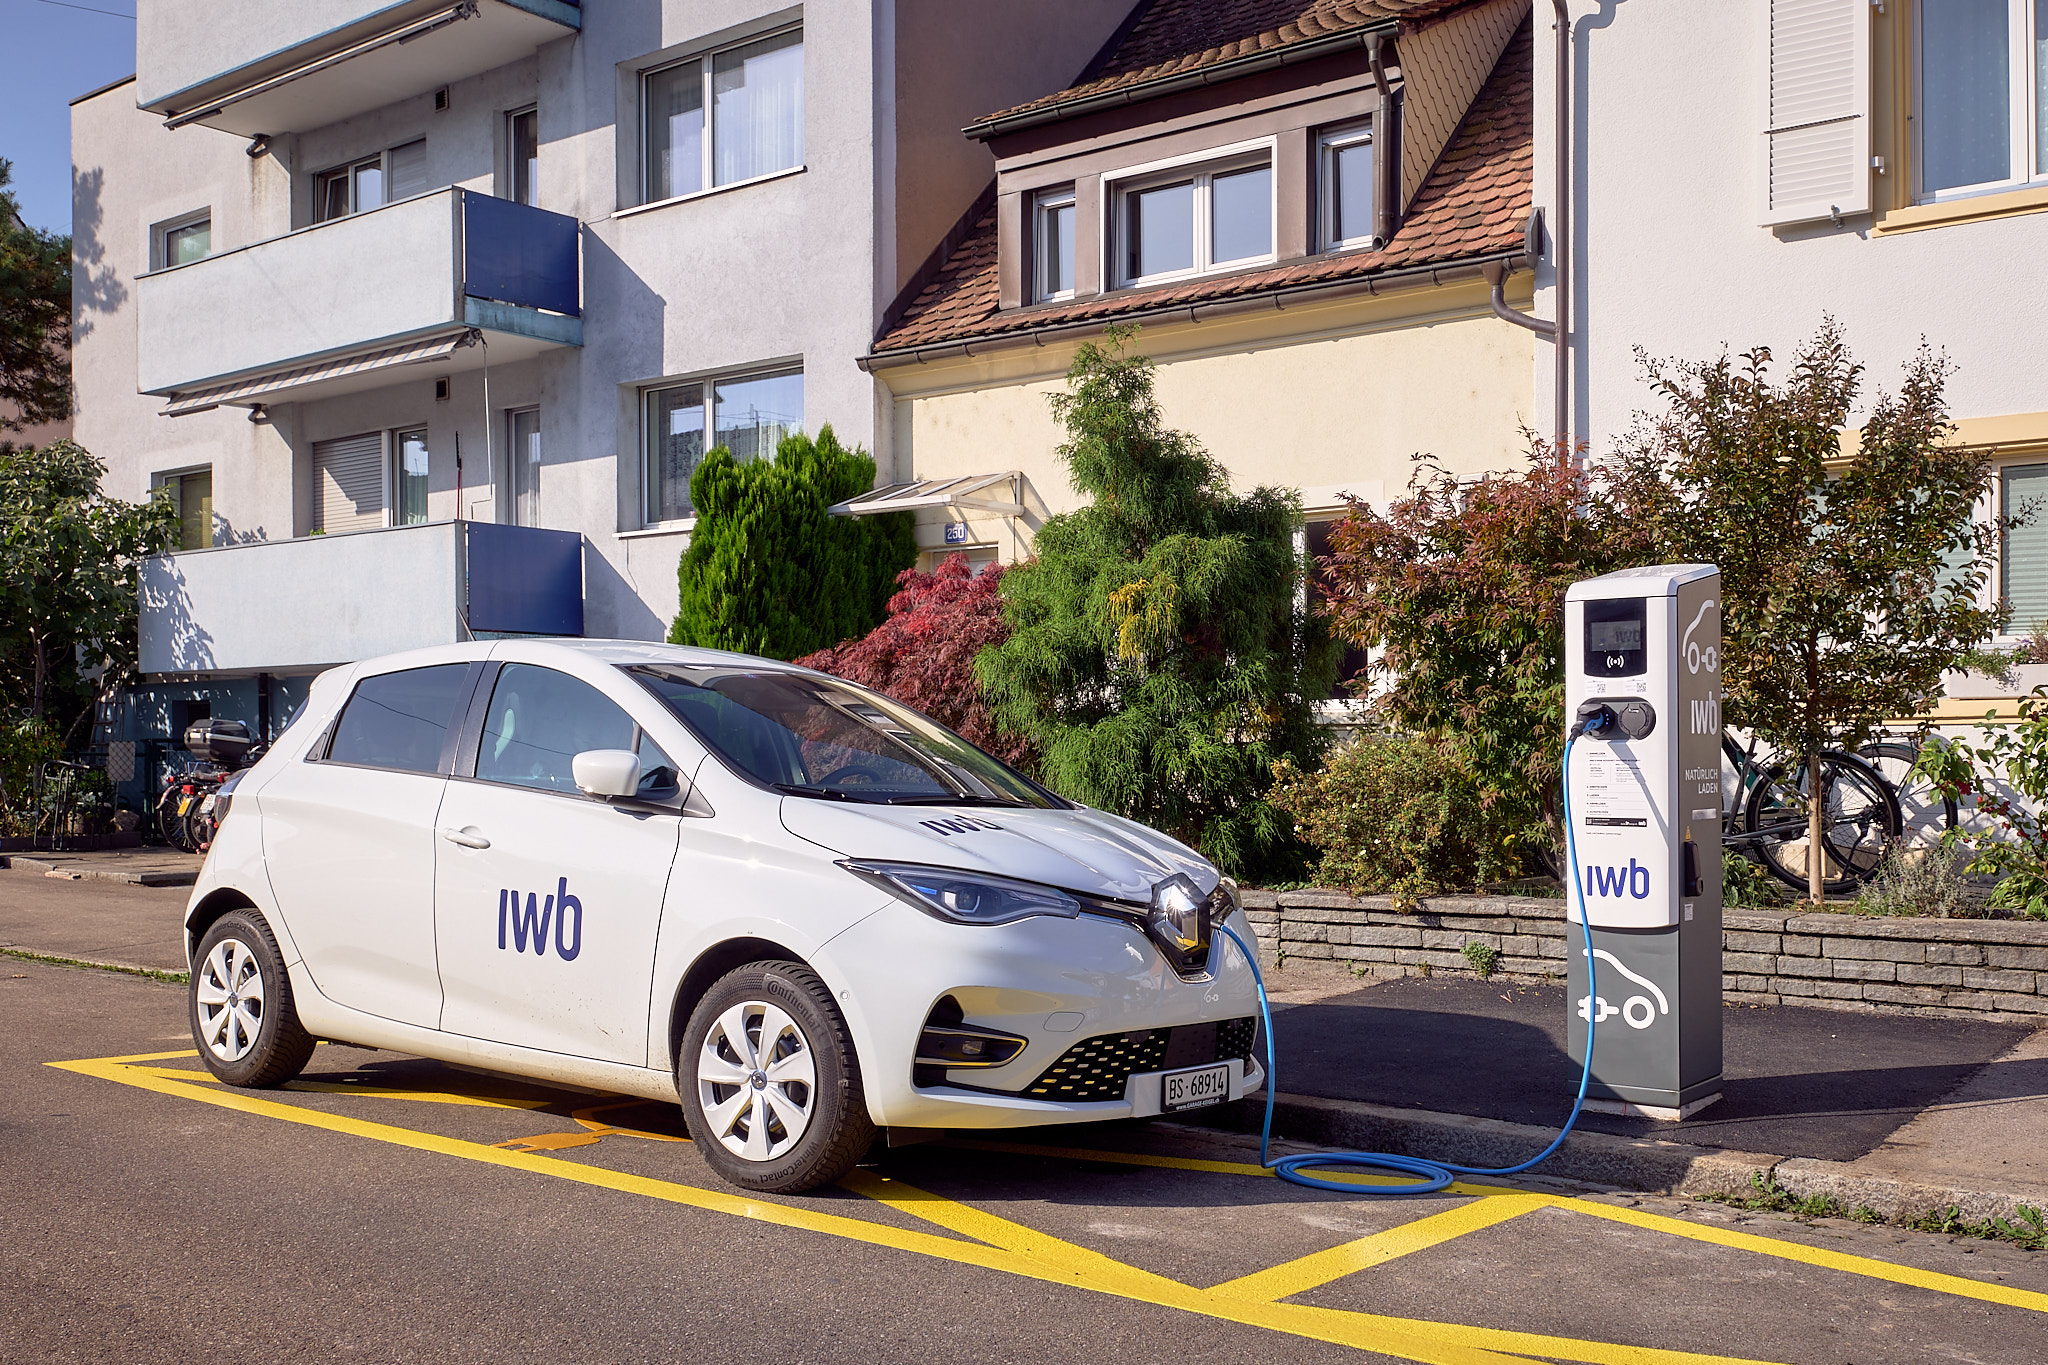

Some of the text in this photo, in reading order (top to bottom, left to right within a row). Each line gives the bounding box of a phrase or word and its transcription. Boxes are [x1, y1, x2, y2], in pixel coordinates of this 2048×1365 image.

[947, 526, 965, 540] 250
[1685, 766, 1718, 781] NATÜRLICH
[1698, 782, 1718, 794] LADEN
[767, 980, 821, 1031] Continental
[759, 1141, 819, 1184] WinterContact
